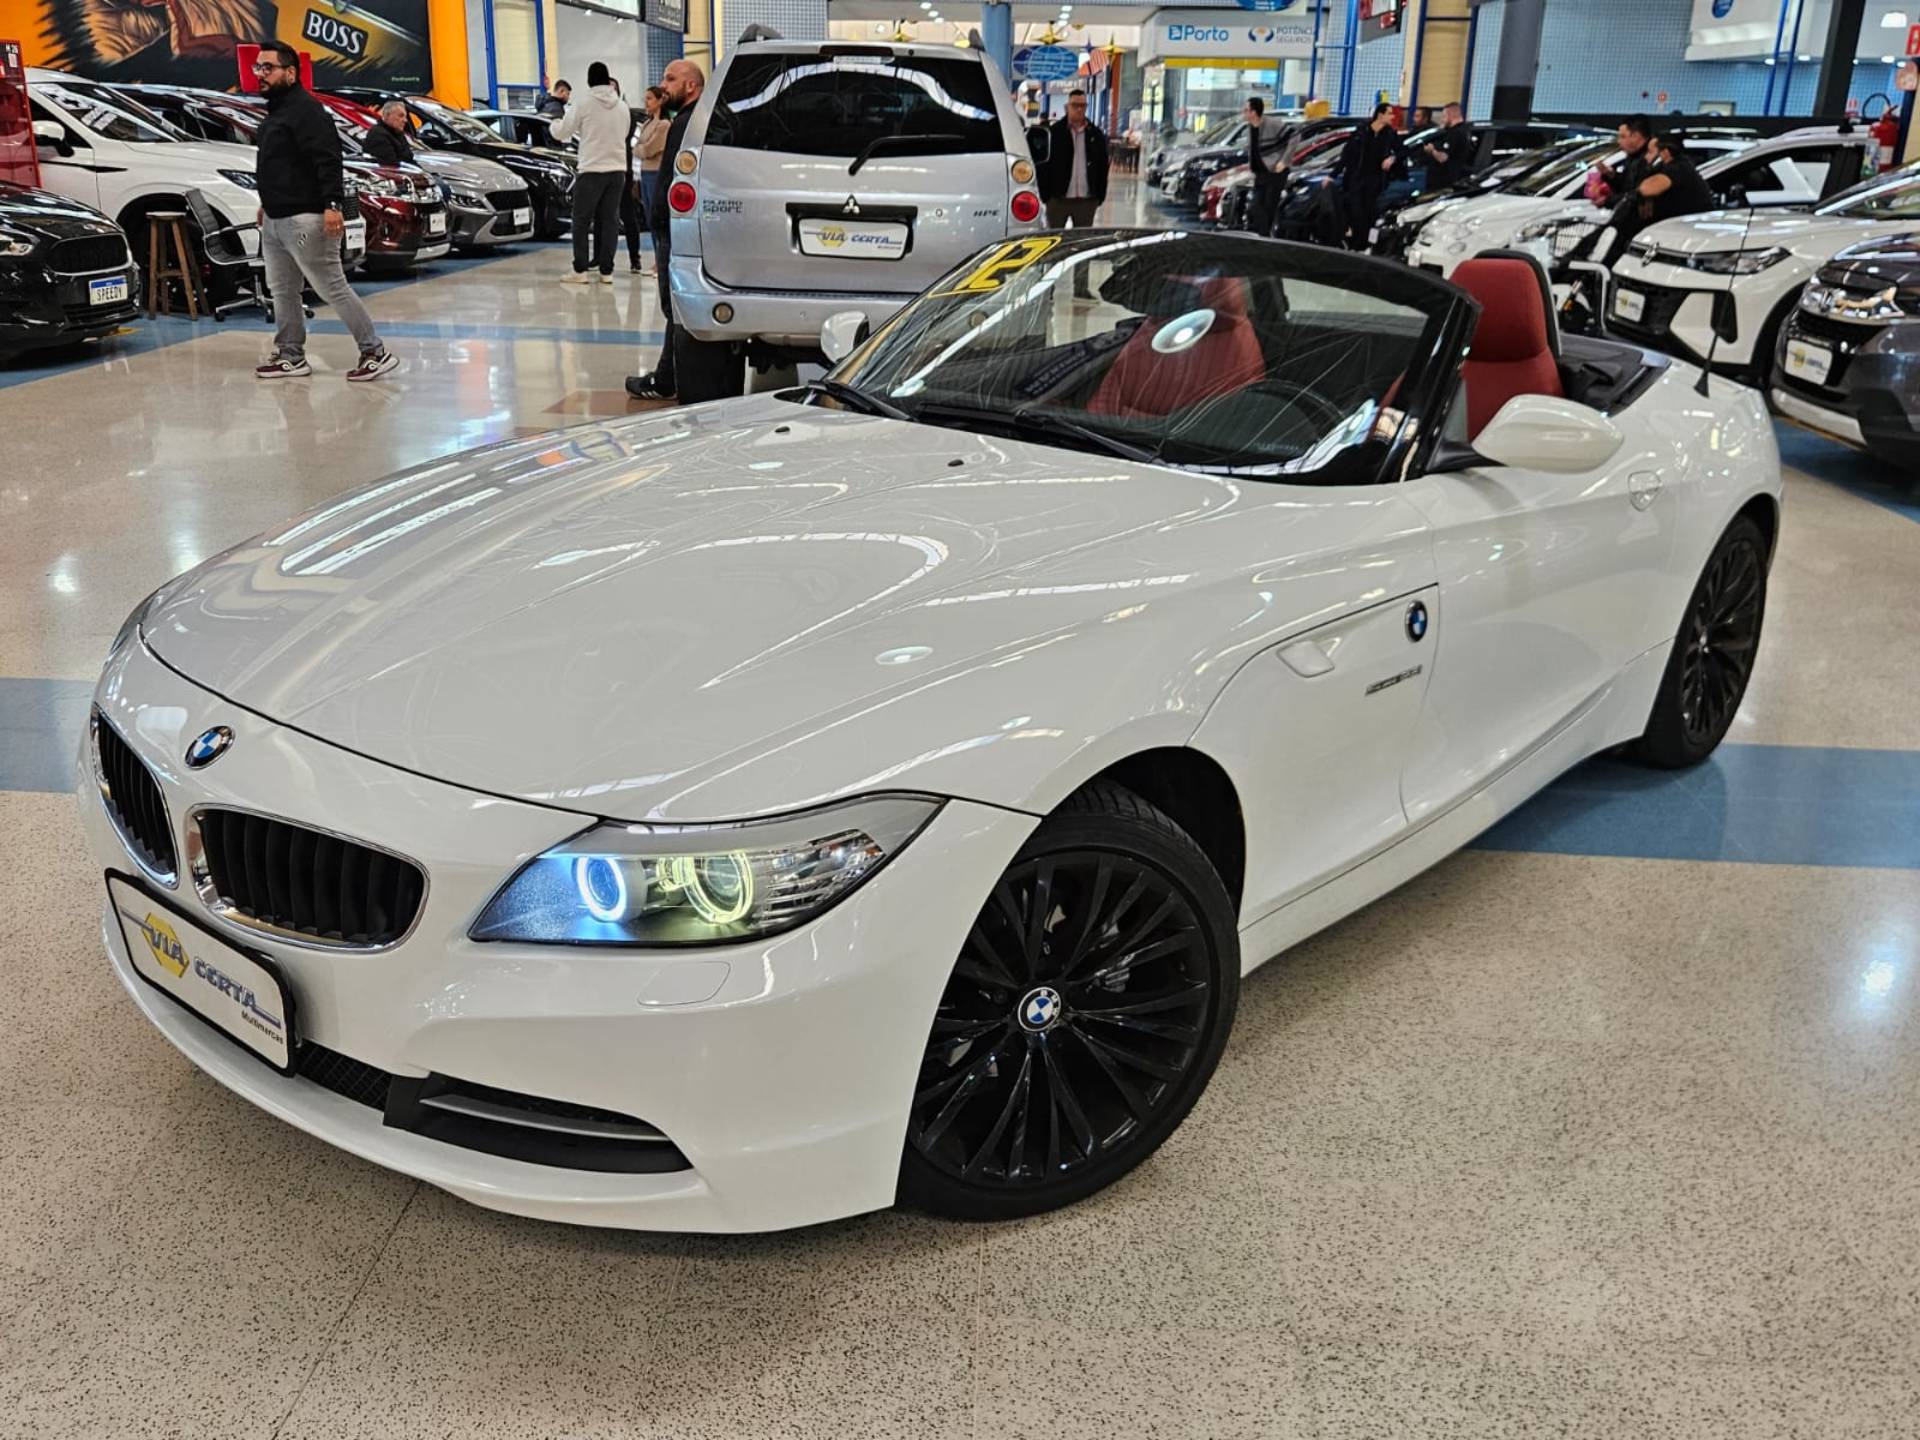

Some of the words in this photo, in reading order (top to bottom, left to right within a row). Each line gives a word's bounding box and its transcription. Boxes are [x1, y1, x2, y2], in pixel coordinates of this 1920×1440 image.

[306, 12, 364, 54] BOSS
[1184, 24, 1230, 42] Porto
[820, 230, 847, 242] VIA
[96, 285, 122, 302] SPEEDY
[151, 927, 186, 967] VIA
[193, 955, 258, 1010] CERTA
[241, 1009, 285, 1045] Multimarcas
